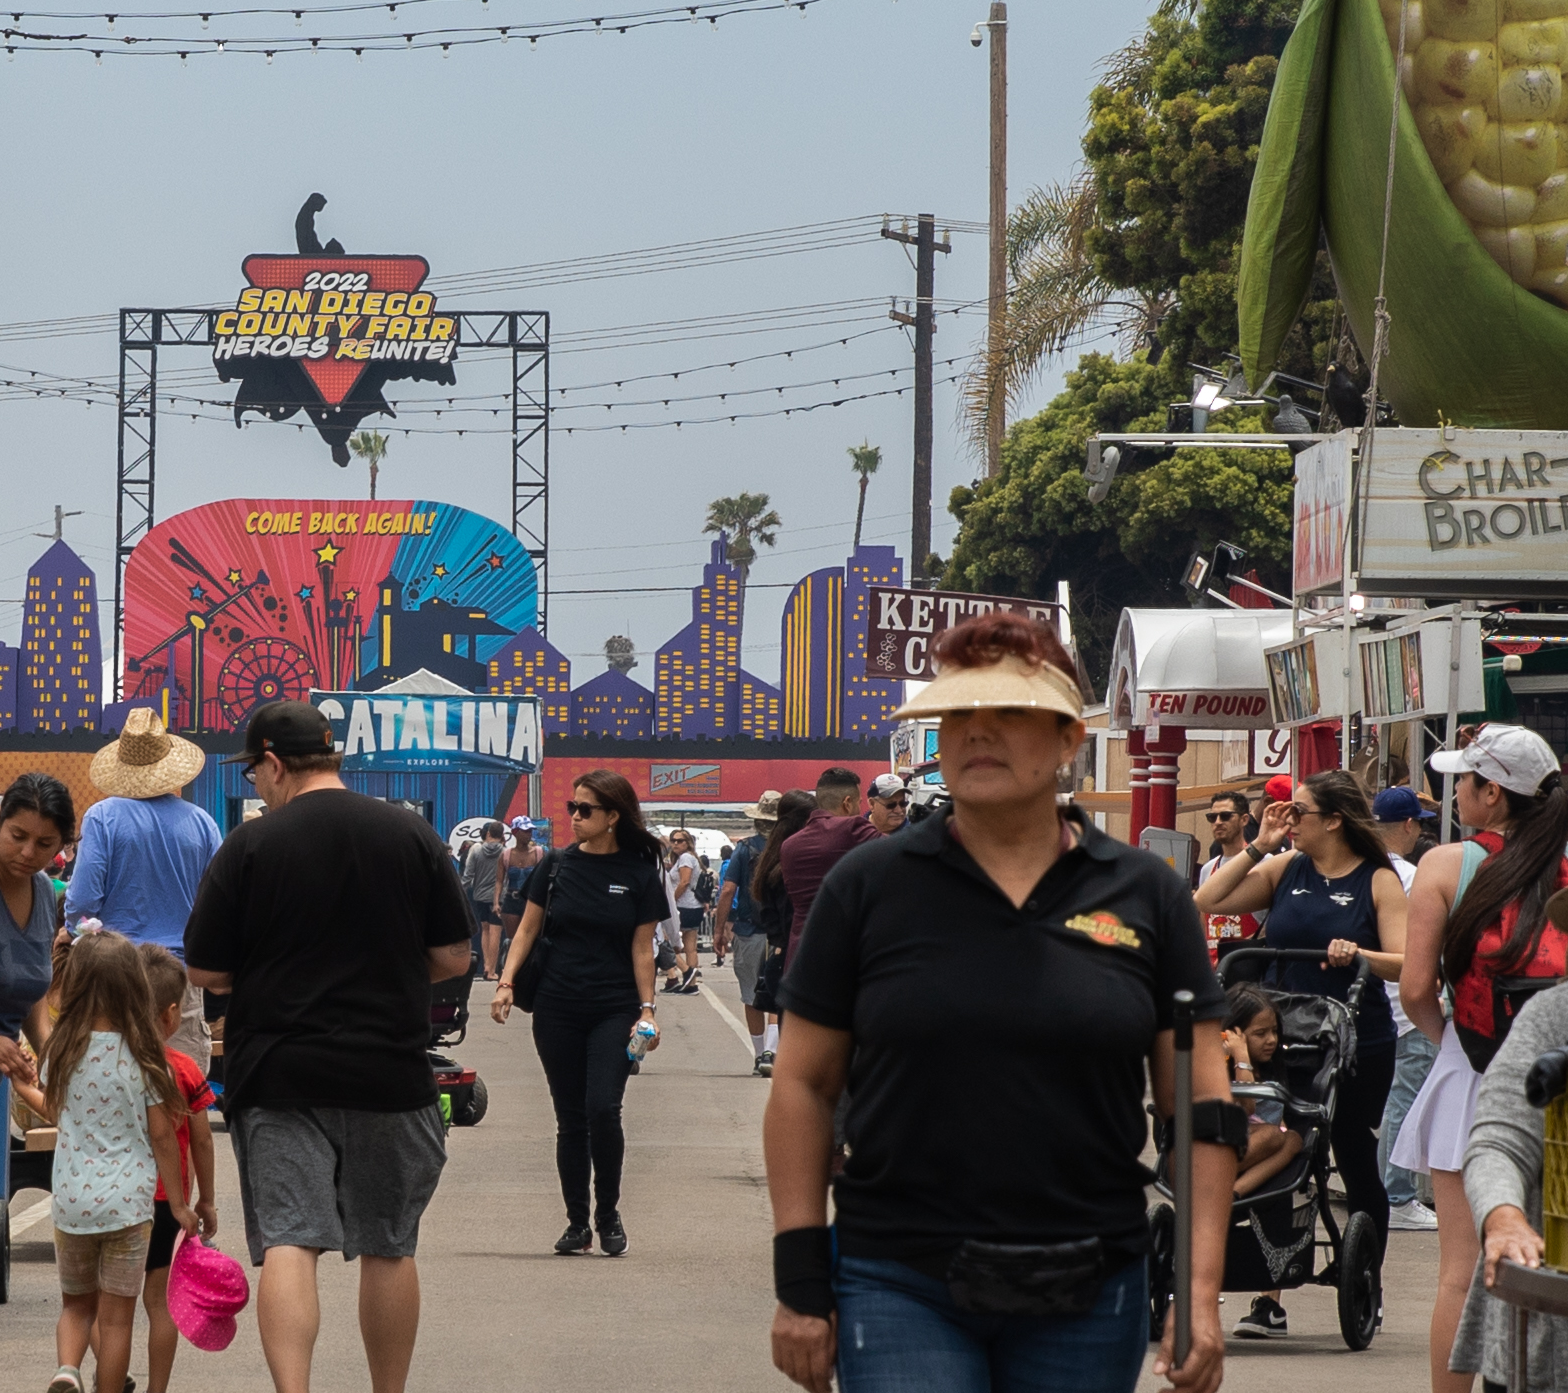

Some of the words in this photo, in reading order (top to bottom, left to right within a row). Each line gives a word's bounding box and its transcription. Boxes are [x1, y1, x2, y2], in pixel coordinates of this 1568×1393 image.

[303, 272, 370, 291] 2022
[238, 288, 313, 314] SAN
[317, 291, 435, 317] DIEGO
[214, 311, 361, 339] COUNTY
[364, 315, 456, 341] FAIR
[214, 335, 331, 360] HEROES
[334, 338, 456, 364] REUNITE!
[245, 511, 304, 536] COME
[307, 511, 360, 535] BACK
[363, 510, 437, 536] AGAIN!
[1148, 693, 1188, 715] TEN
[1192, 694, 1268, 717] POUND
[318, 698, 538, 765] CATALINA
[406, 759, 450, 767] EXPLORE
[652, 764, 691, 789] EXIT
